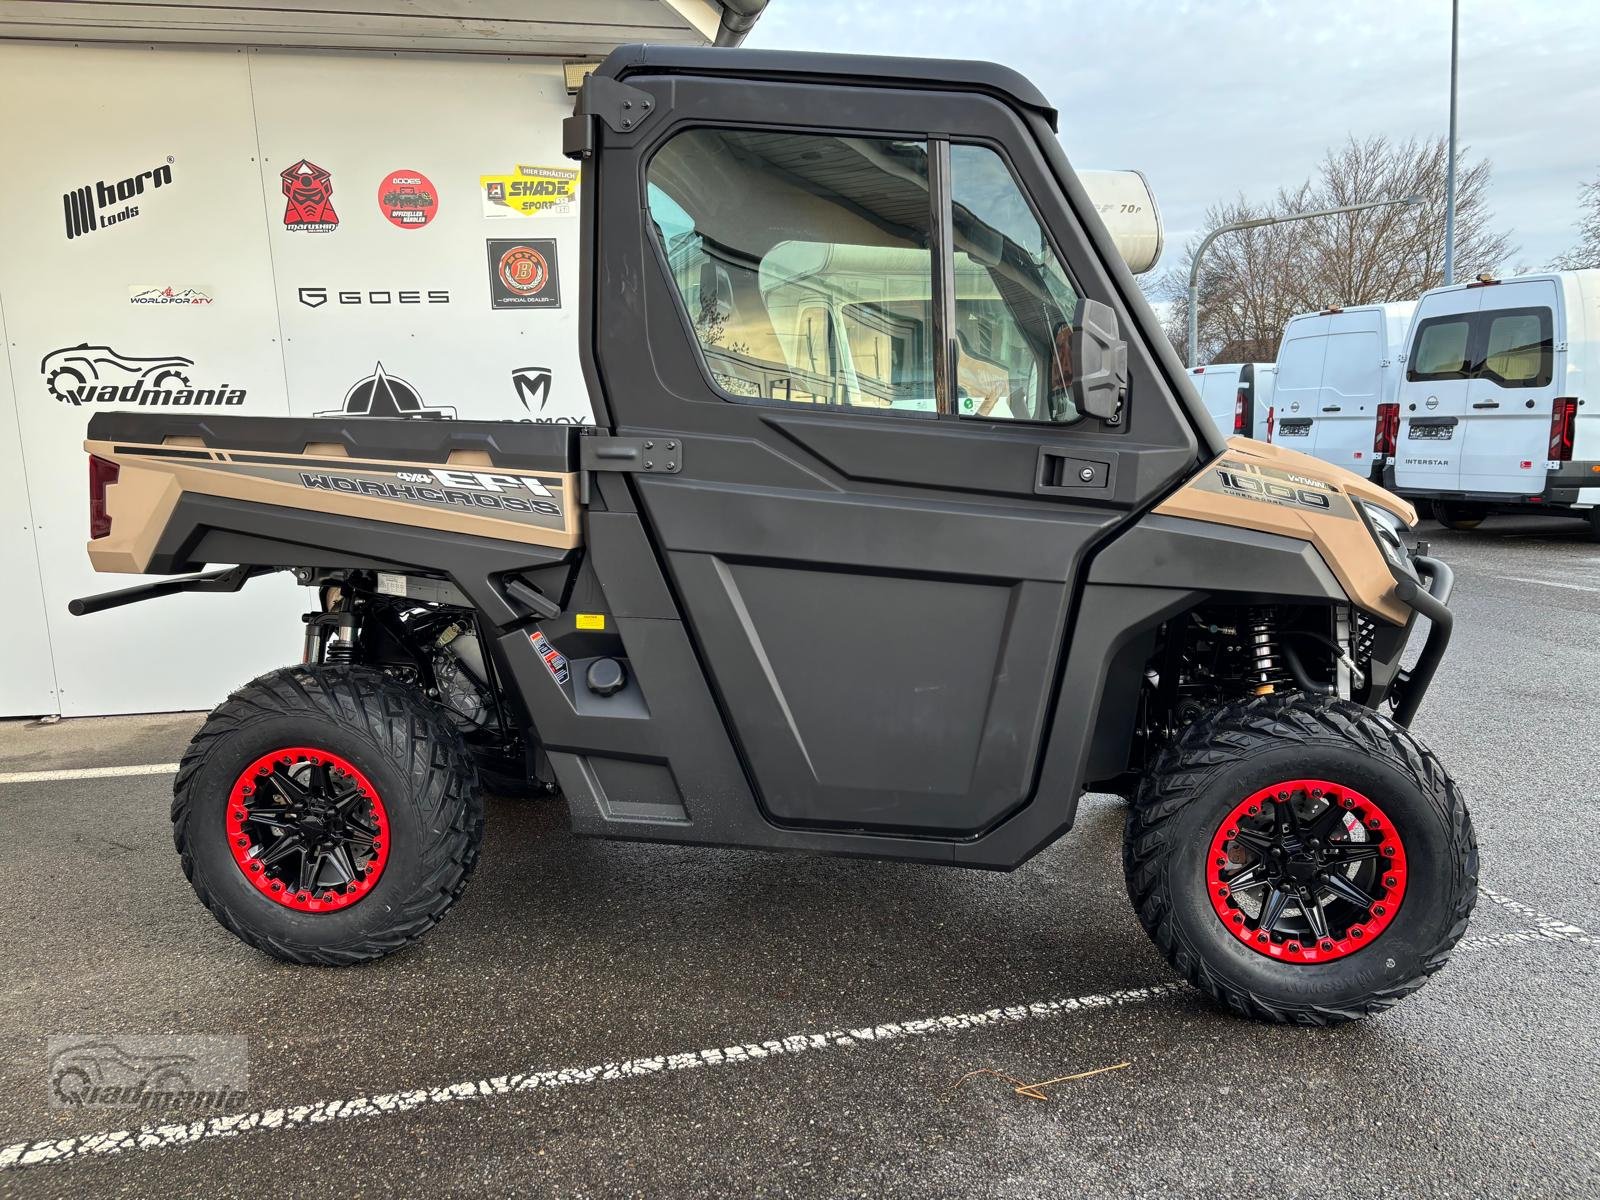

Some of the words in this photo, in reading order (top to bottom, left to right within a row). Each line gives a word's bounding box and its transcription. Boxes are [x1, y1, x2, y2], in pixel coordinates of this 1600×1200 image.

[96, 165, 172, 208] horn
[509, 181, 569, 196] SHADE
[521, 201, 554, 210] SPORT
[100, 206, 139, 228] tools
[338, 291, 450, 304] GOES
[1216, 469, 1330, 510] 1000
